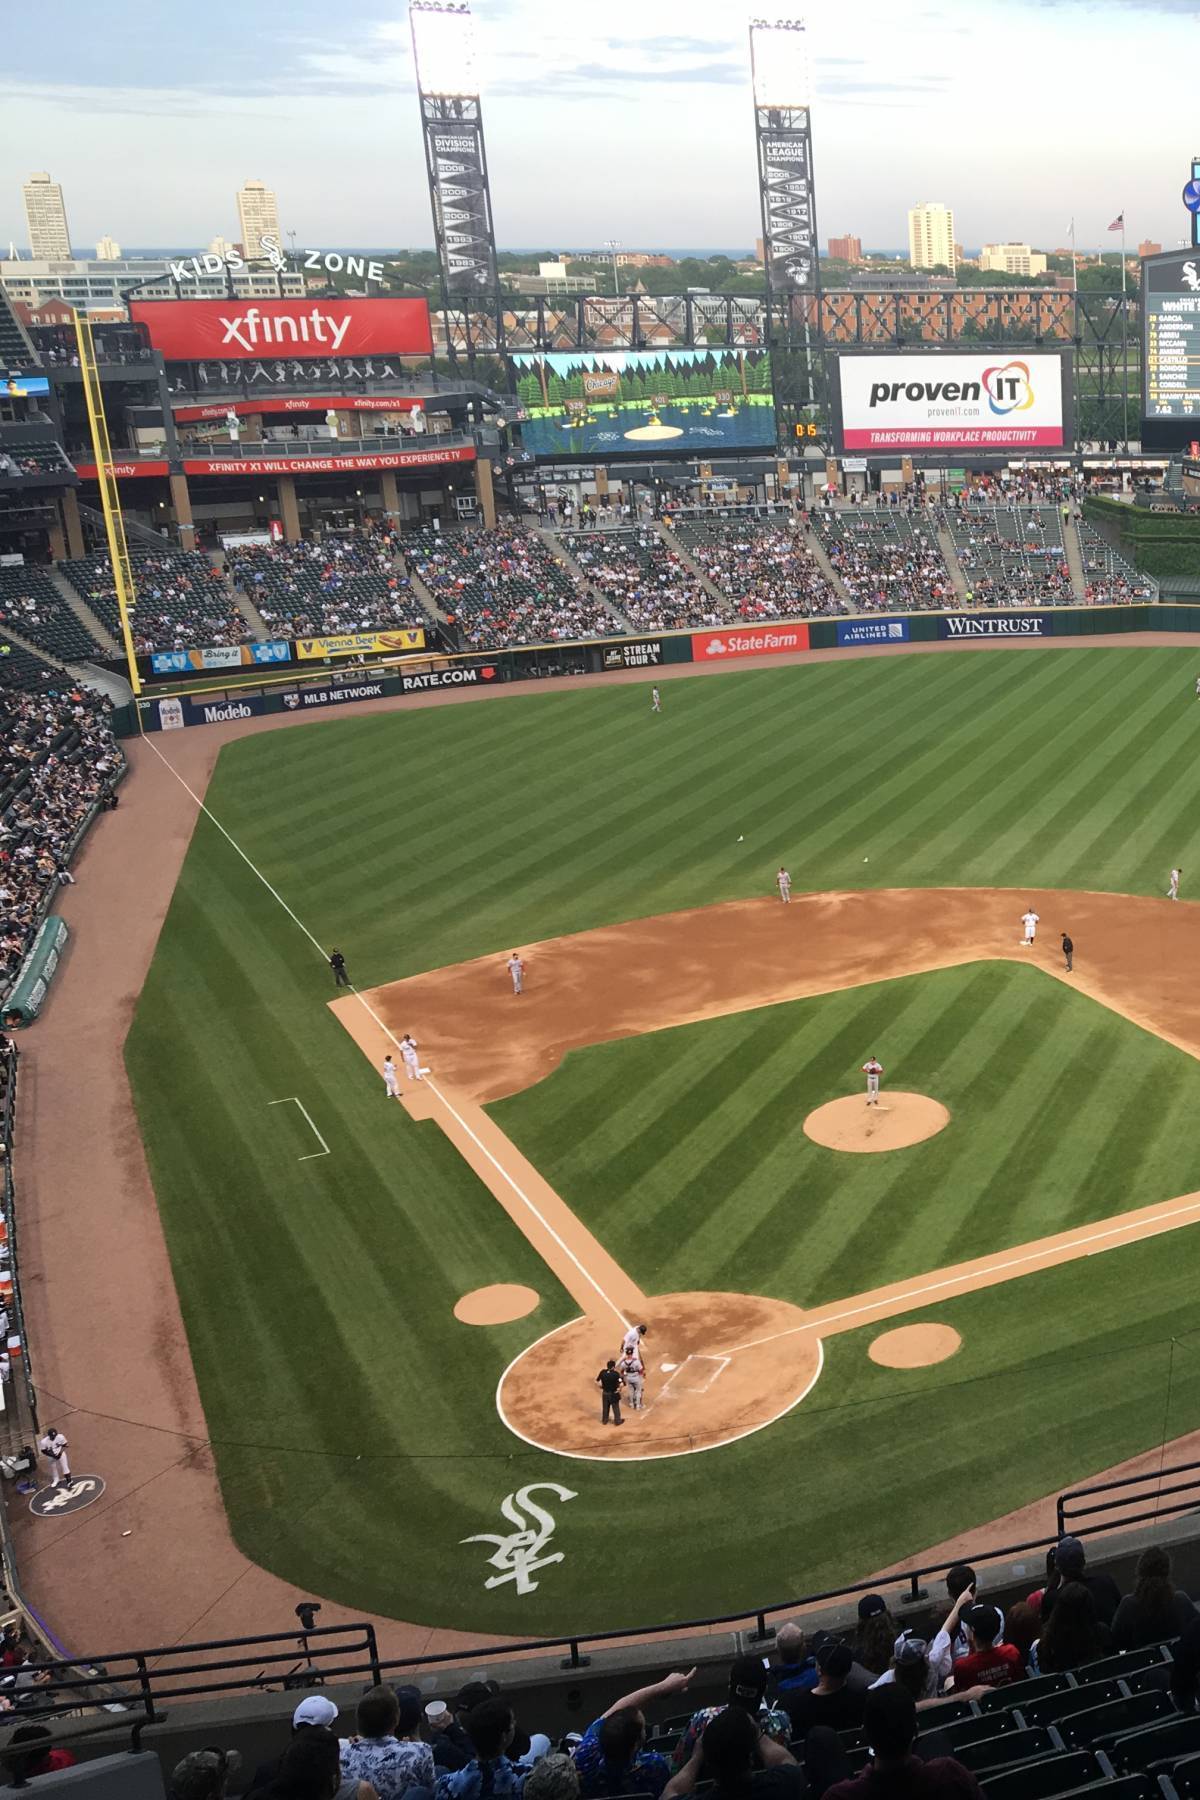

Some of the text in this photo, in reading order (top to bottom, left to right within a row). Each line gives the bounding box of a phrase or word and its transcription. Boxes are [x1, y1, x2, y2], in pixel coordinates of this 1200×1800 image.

[435, 139, 475, 148] DIVISION
[766, 141, 803, 149] AMERICAN
[767, 148, 804, 156] LEAGUE
[170, 250, 244, 282] KIDS
[304, 249, 385, 282] ZONE
[1163, 302, 1195, 311] WHITE
[219, 308, 352, 351] xfinity
[586, 377, 616, 391] Chicago
[869, 377, 1021, 407] proven IT
[285, 400, 309, 409] xfinity
[354, 399, 401, 408] xfinity.com/x1
[927, 407, 980, 417] provenIT.com
[1183, 406, 1193, 414] 17
[870, 430, 1038, 443] TRANSFORMING WORKPLACE PRODUCTIVITY
[208, 450, 461, 472] XFINITY X1 WILL CHANGE THE WAY YOU EXPERIENCE TV
[852, 625, 887, 634] UNITED
[947, 617, 1042, 633] WINTRUST
[320, 635, 376, 647] Vienna Beef
[844, 631, 887, 640] AIRLINES
[204, 650, 230, 658] Bring
[624, 643, 660, 655] STREAM
[624, 655, 648, 665] YOUR
[403, 669, 477, 690] RATE.COM
[304, 685, 382, 704] MLB NETWORK
[204, 704, 251, 723] Modelo
